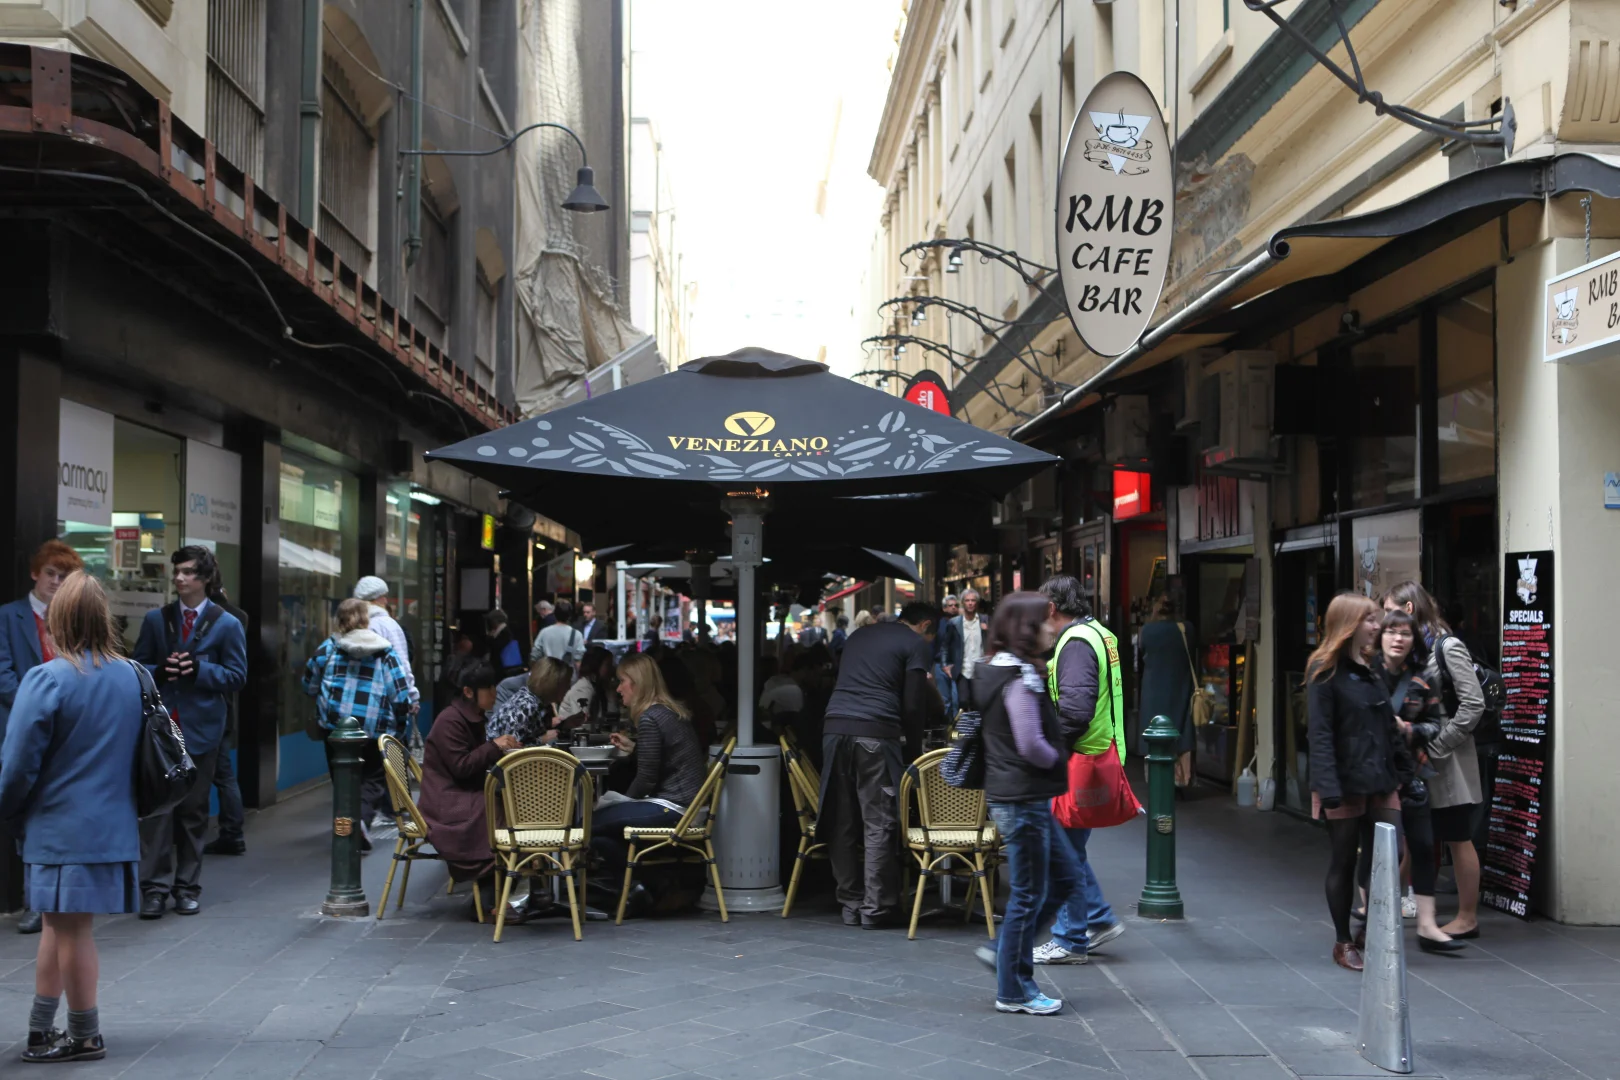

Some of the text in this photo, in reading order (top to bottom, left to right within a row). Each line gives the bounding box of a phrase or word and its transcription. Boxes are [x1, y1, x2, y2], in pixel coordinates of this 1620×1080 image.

[1112, 146, 1126, 155] 9671
[1126, 149, 1144, 159] 4455
[1065, 193, 1164, 236] RMB
[1071, 242, 1154, 276] CAFE
[1077, 284, 1143, 316] BAR
[1588, 269, 1618, 306] RMB
[1607, 302, 1620, 329] B
[667, 436, 829, 452] VENEZIANO
[189, 492, 208, 516] OPEN
[1509, 610, 1544, 623] SPECIALS
[1484, 892, 1526, 915] PH: 9671 4455
